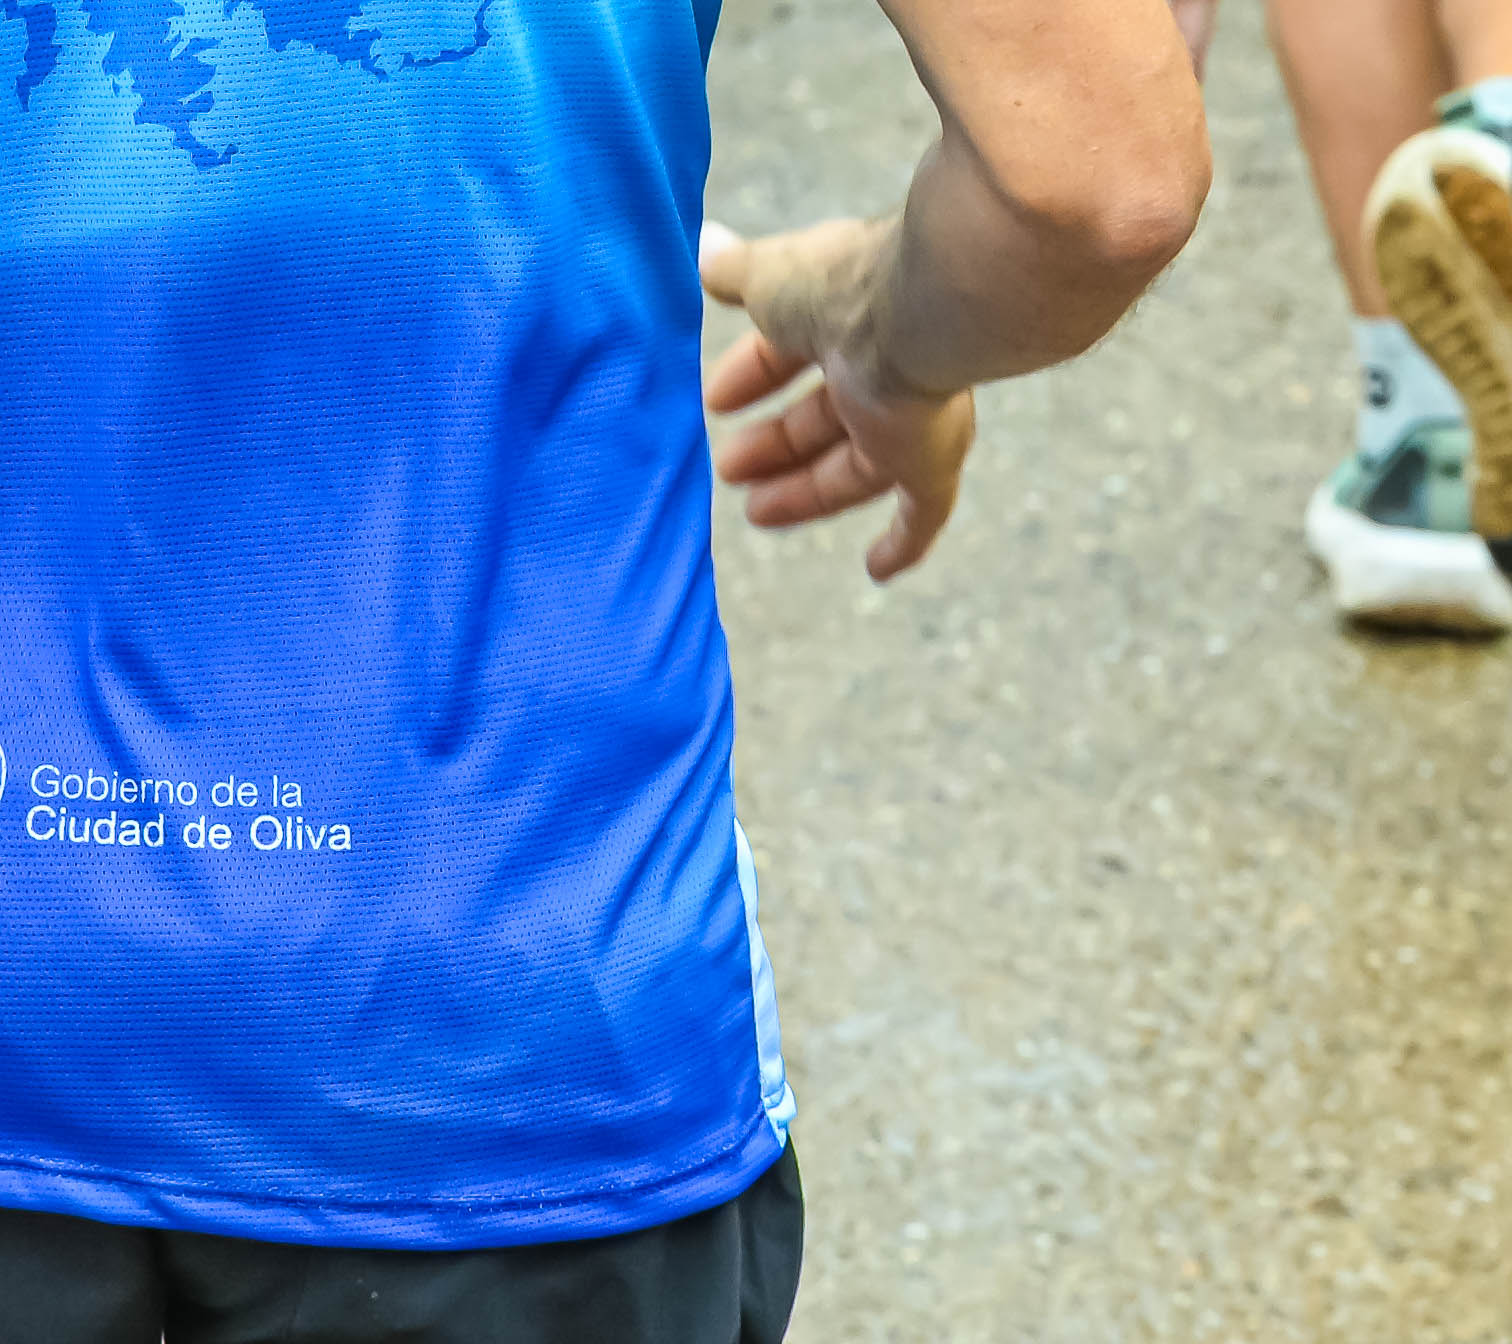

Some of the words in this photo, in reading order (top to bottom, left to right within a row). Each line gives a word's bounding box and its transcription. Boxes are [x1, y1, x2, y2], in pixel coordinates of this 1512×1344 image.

[30, 764, 198, 806] Gobierno
[210, 775, 258, 808] de
[272, 775, 303, 808] la
[25, 805, 166, 848] Ciudad
[183, 815, 232, 850] de
[249, 814, 352, 851] Oliva
